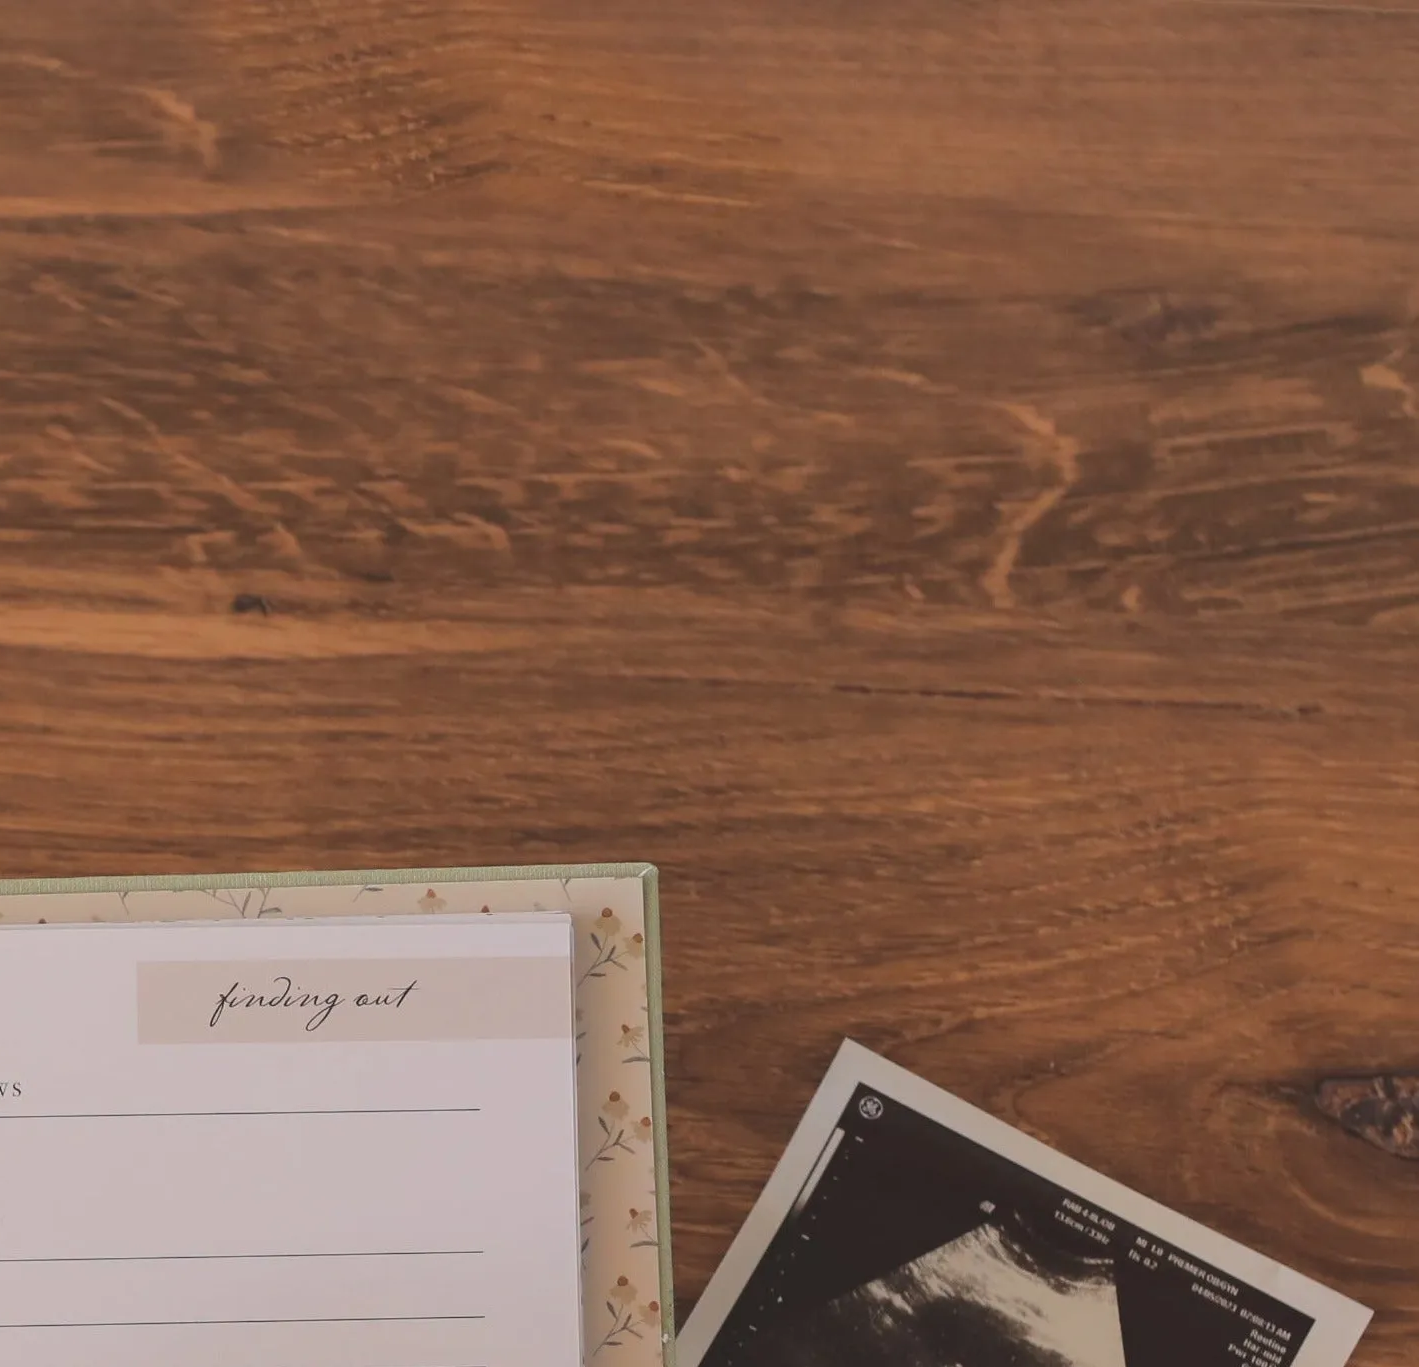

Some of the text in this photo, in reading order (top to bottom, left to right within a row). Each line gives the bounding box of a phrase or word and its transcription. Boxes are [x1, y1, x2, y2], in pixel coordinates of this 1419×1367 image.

[210, 977, 418, 1031] finding out
[1250, 1329, 1286, 1354] Routine
